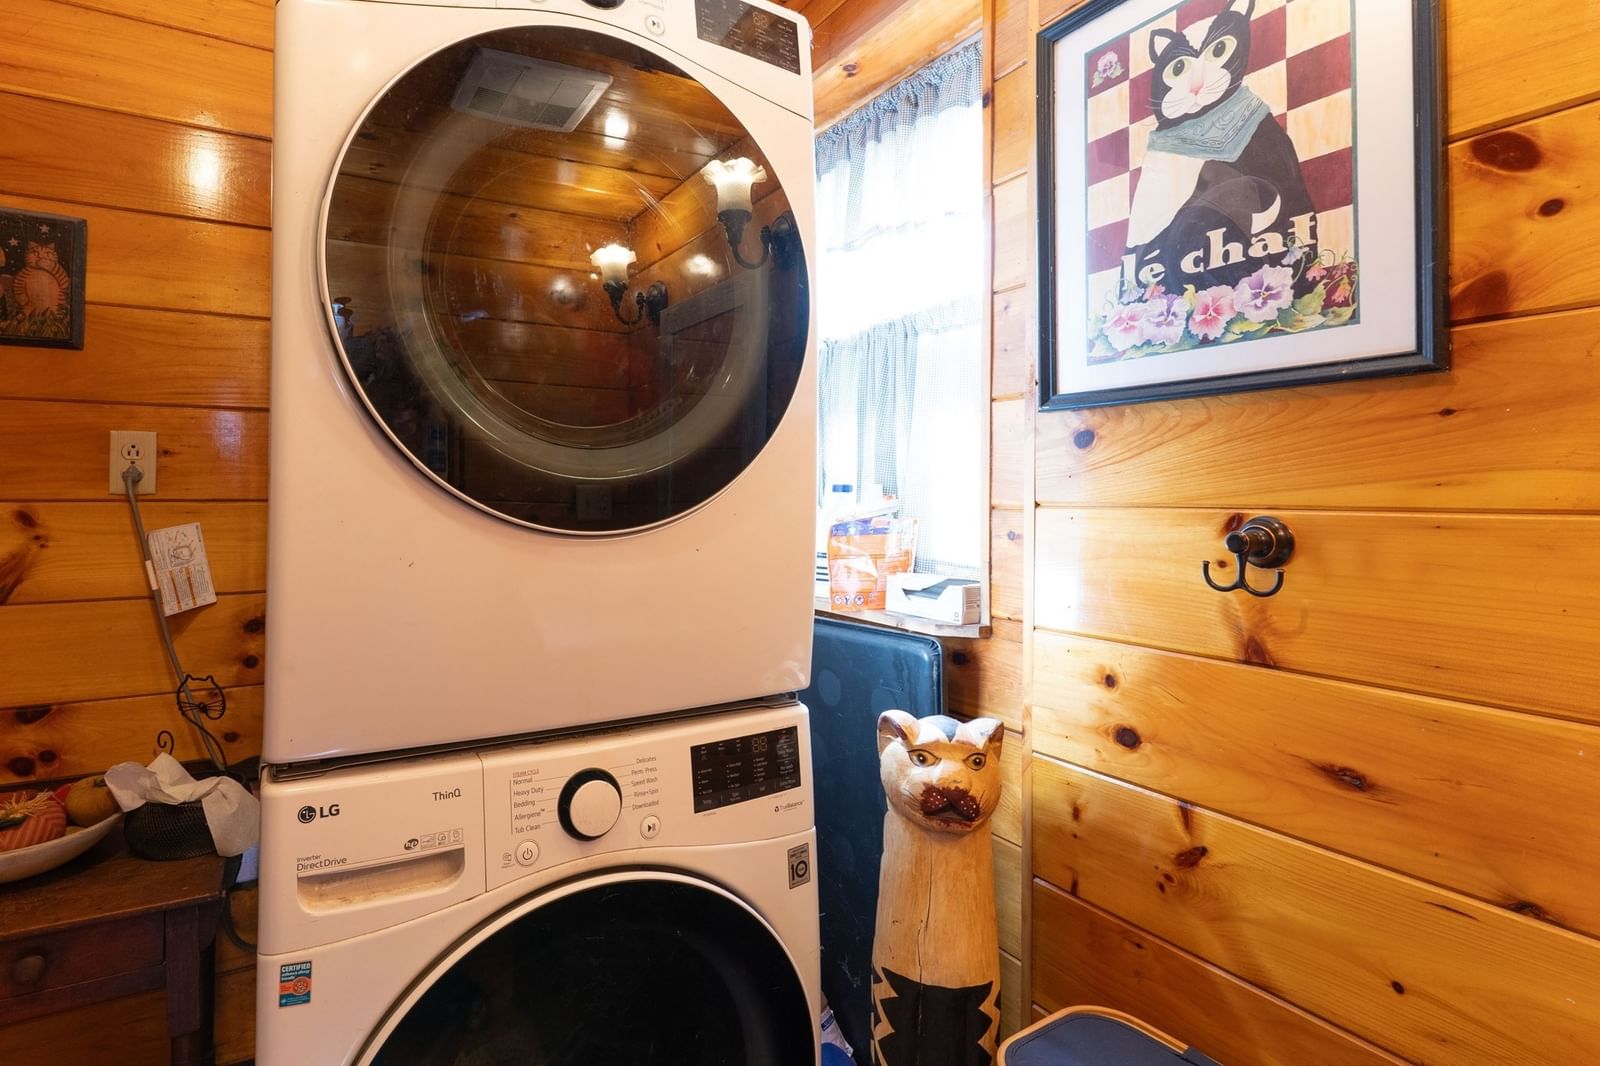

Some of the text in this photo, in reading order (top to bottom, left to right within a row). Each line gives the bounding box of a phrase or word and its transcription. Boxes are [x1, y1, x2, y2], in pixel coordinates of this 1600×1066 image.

[636, 756, 657, 764] Delicates
[513, 777, 533, 786] Normal
[631, 779, 646, 787] Speed
[432, 787, 462, 802] ThinQ
[513, 786, 544, 798] Heavy Duty
[514, 799, 536, 809] Bedding
[632, 799, 660, 810] Downloaded
[319, 803, 340, 820] LG
[515, 824, 541, 835] Tub Clean
[297, 853, 322, 863] Inverter
[281, 963, 311, 973] CERTIFIED
